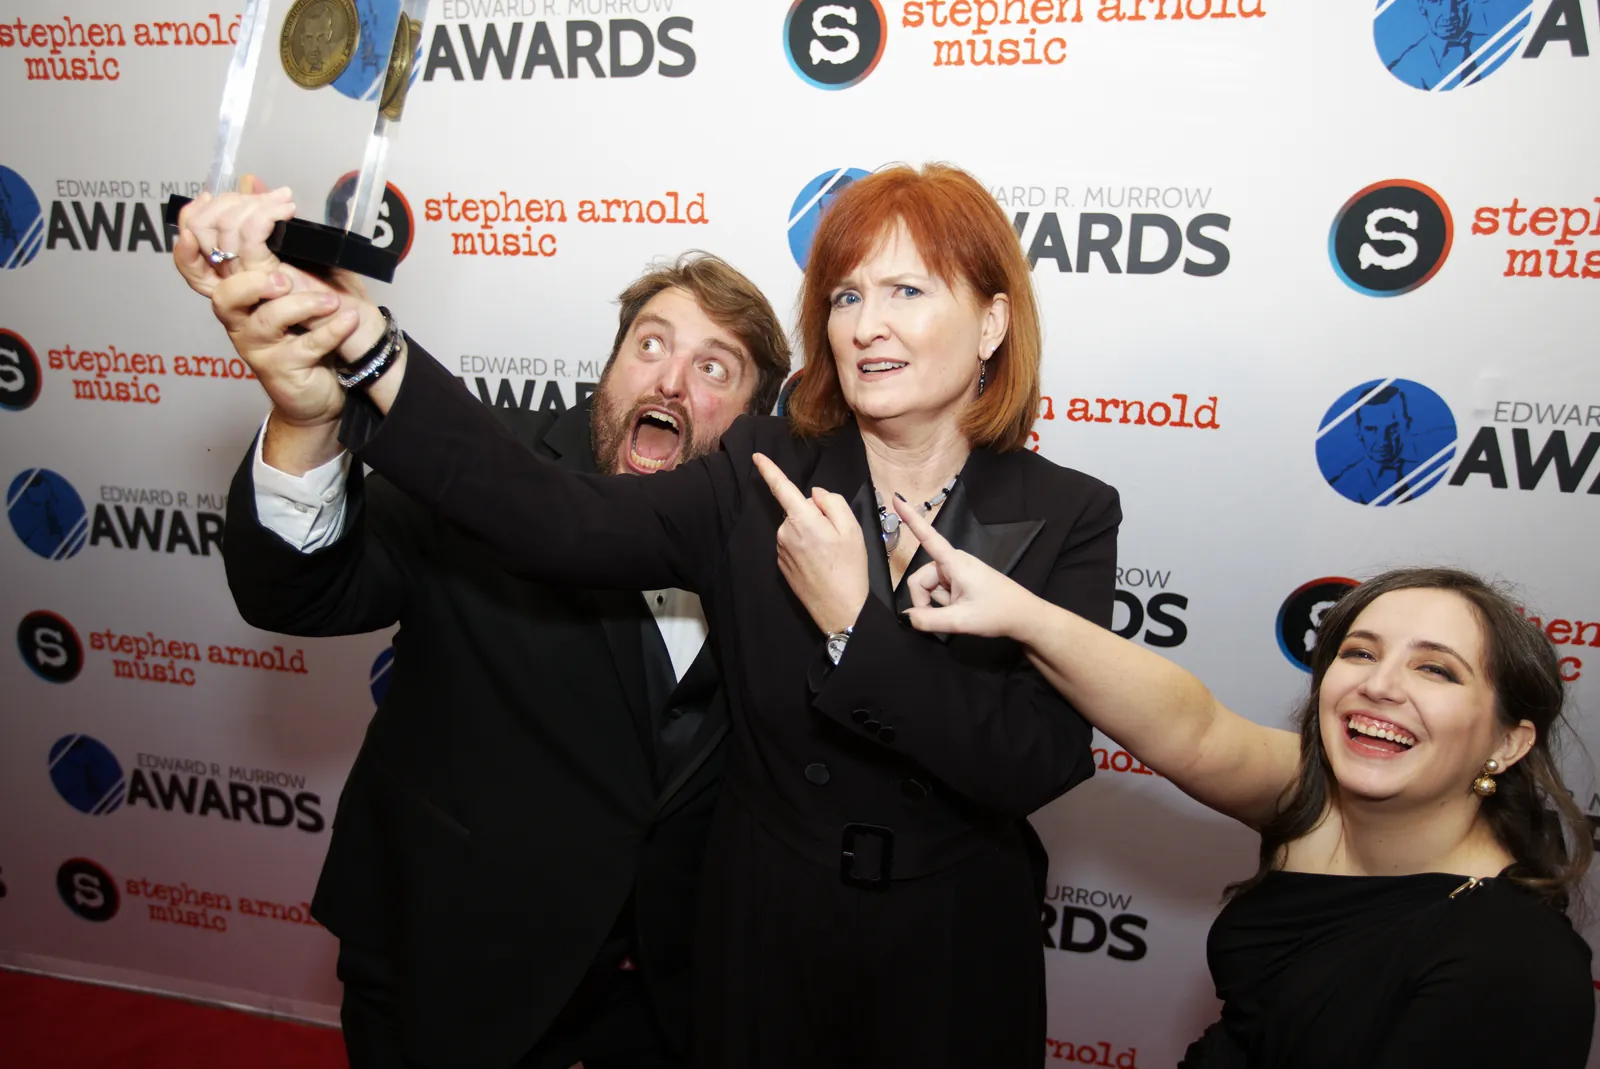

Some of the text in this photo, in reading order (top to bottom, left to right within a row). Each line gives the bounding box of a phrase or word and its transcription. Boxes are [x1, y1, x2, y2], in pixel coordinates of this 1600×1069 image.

[444, 0, 673, 19] EDWARD R. MURROW
[901, 0, 1083, 34] stephen
[0, 16, 126, 54] stephen
[422, 16, 696, 81] AWARDS
[933, 29, 1066, 66] music
[25, 50, 119, 81] music
[56, 180, 135, 198] EDWARD
[990, 186, 1212, 209] ARD R. MURROW
[46, 201, 178, 252] AWA
[425, 192, 709, 229] stephen arnold
[1471, 197, 1600, 246] step
[452, 226, 556, 257] music
[1011, 212, 1231, 277] ARDS
[1503, 249, 1600, 279] mus
[48, 344, 258, 380] stephen arno
[460, 355, 548, 376] EDWARD
[73, 376, 161, 404] music
[1066, 393, 1220, 429] arnold
[1494, 401, 1600, 426] EDWAR
[100, 486, 173, 507] EDWARD
[90, 503, 225, 556] AWAR
[1116, 567, 1171, 589] ROW
[89, 628, 309, 674] stephen arnold
[113, 658, 196, 686] music
[137, 753, 207, 776] EDWARD
[228, 765, 306, 789] MURROW
[127, 768, 325, 833] AWARDS
[126, 877, 324, 930] stephen arnol
[1046, 885, 1132, 911] URROW
[148, 903, 227, 932] music
[1042, 902, 1148, 962] RDS
[1046, 1037, 1139, 1069] nold
